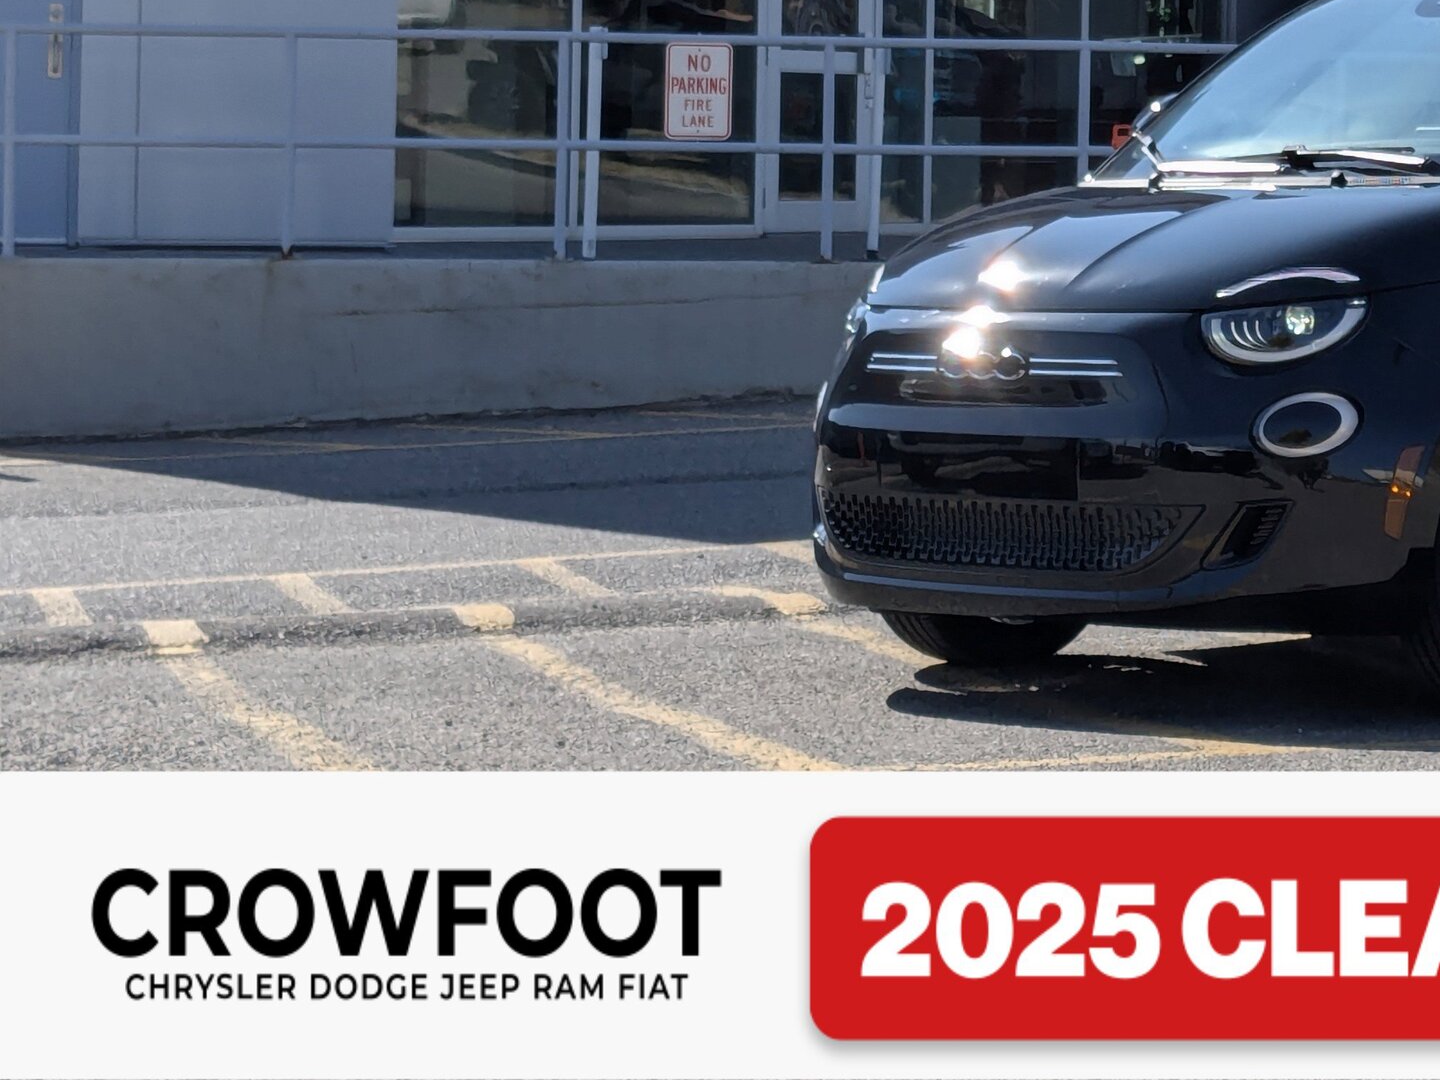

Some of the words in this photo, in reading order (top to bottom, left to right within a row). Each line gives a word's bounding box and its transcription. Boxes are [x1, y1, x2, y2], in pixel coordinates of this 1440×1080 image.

[687, 54, 711, 72] NO
[671, 76, 727, 95] PARKING
[684, 99, 712, 112] FIRE
[682, 115, 714, 128] LANE
